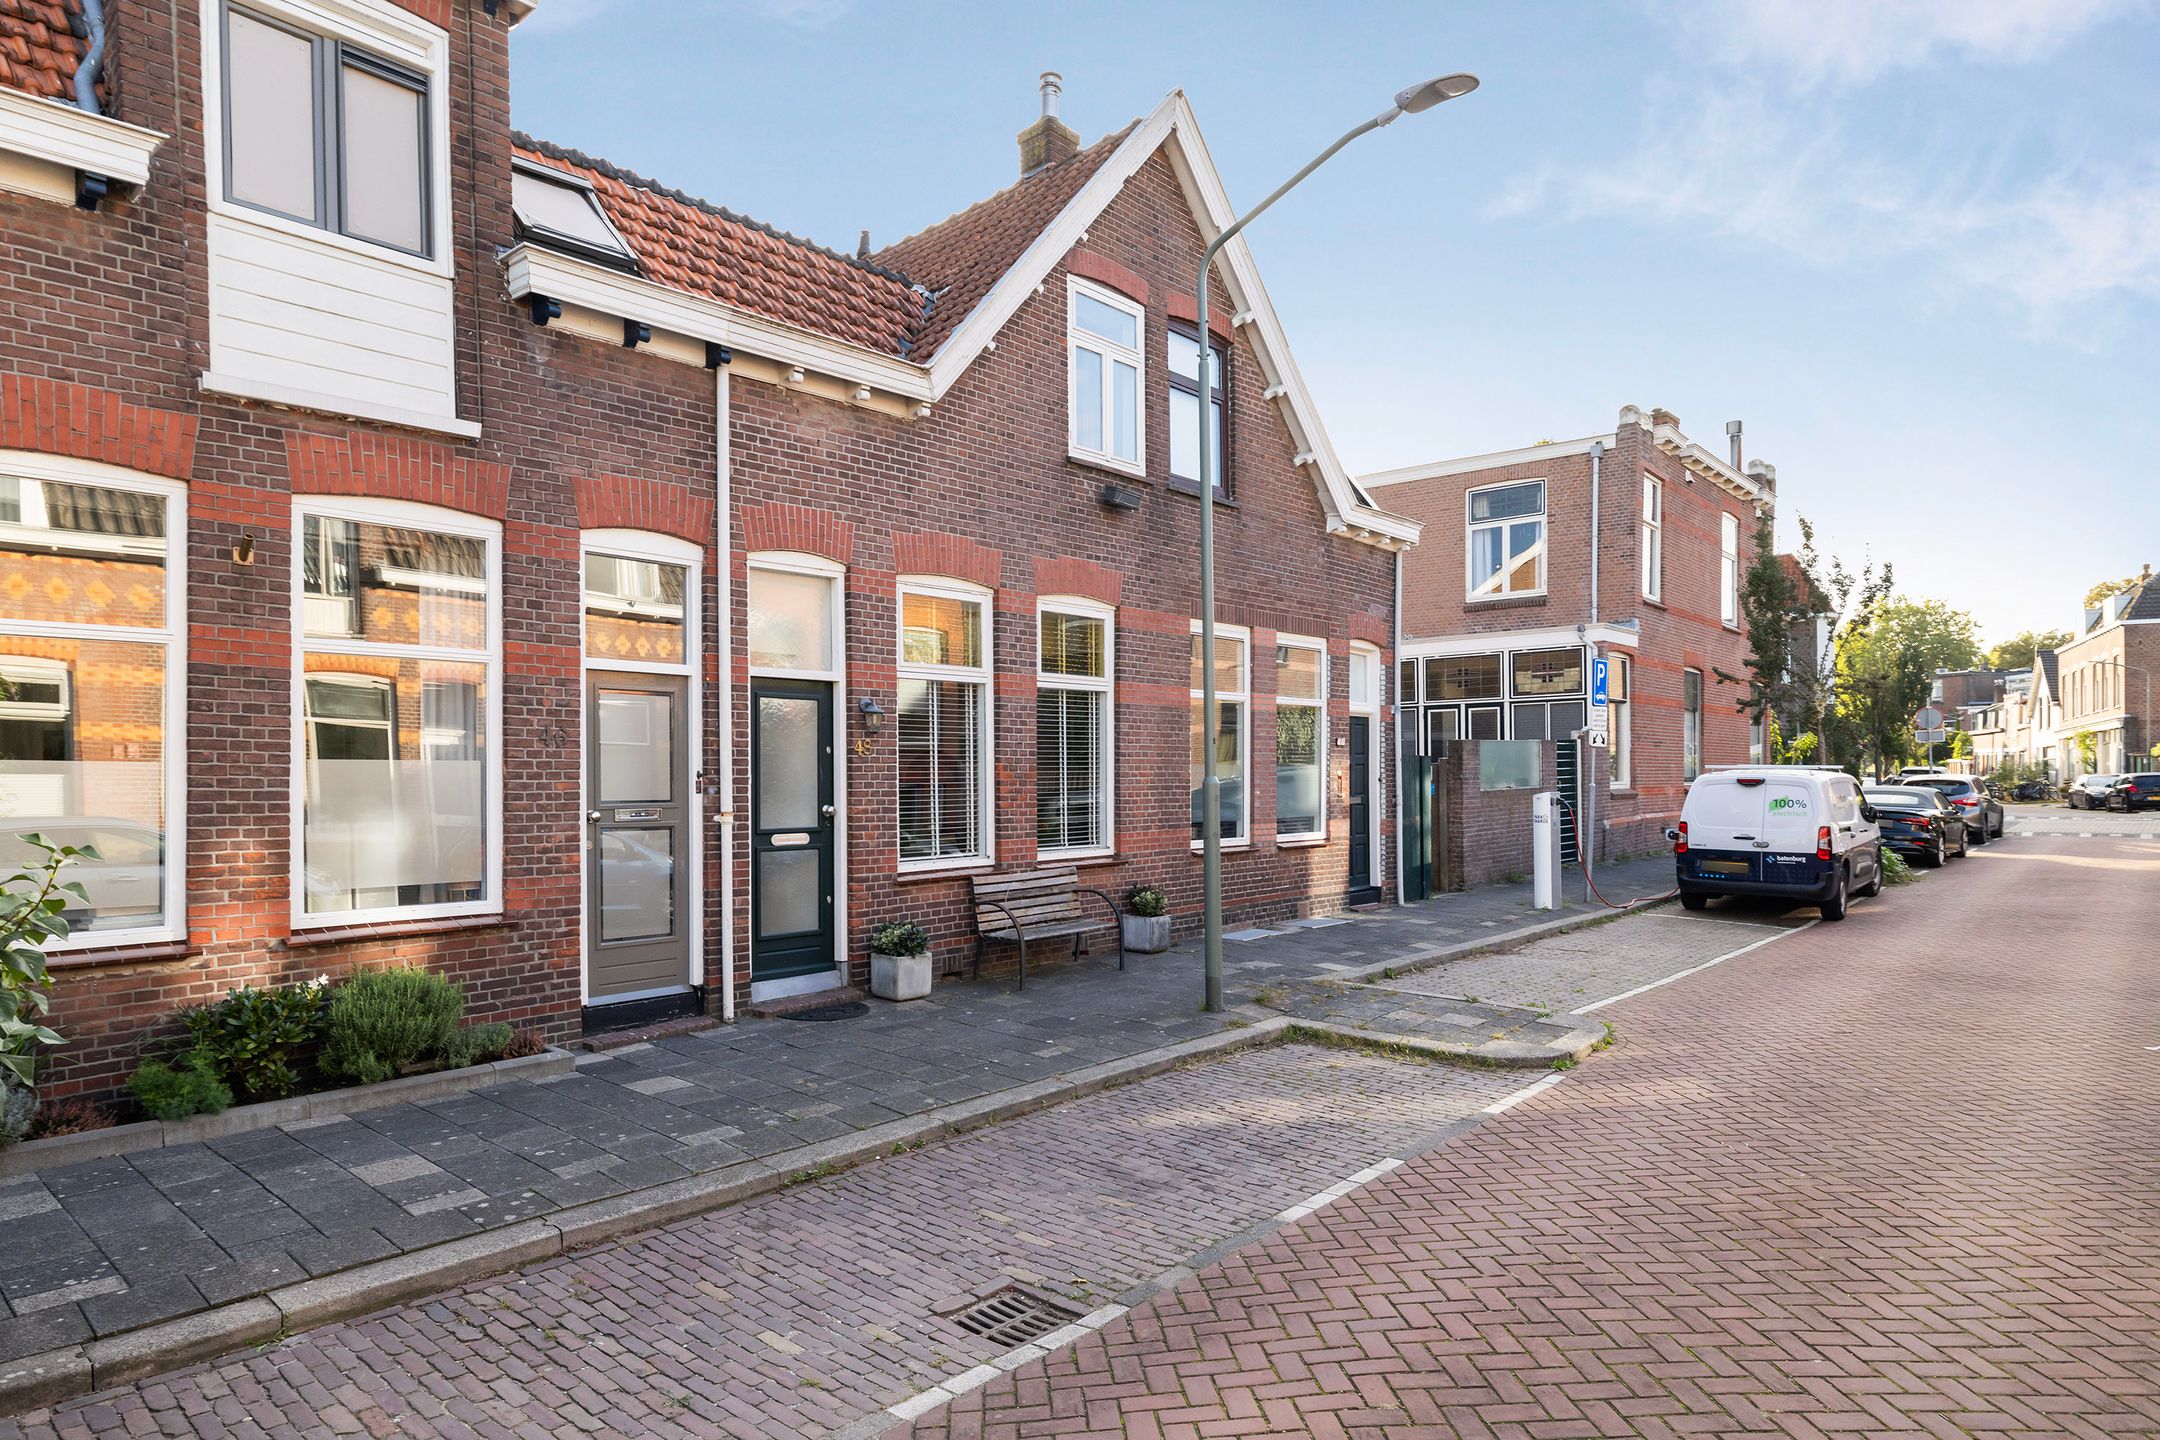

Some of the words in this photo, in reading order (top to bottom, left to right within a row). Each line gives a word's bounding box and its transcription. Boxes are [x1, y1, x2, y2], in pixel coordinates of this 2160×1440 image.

[1597, 663, 1606, 687] P
[539, 725, 567, 749] 46
[854, 739, 871, 757] 48
[1773, 799, 1807, 808] 100%
